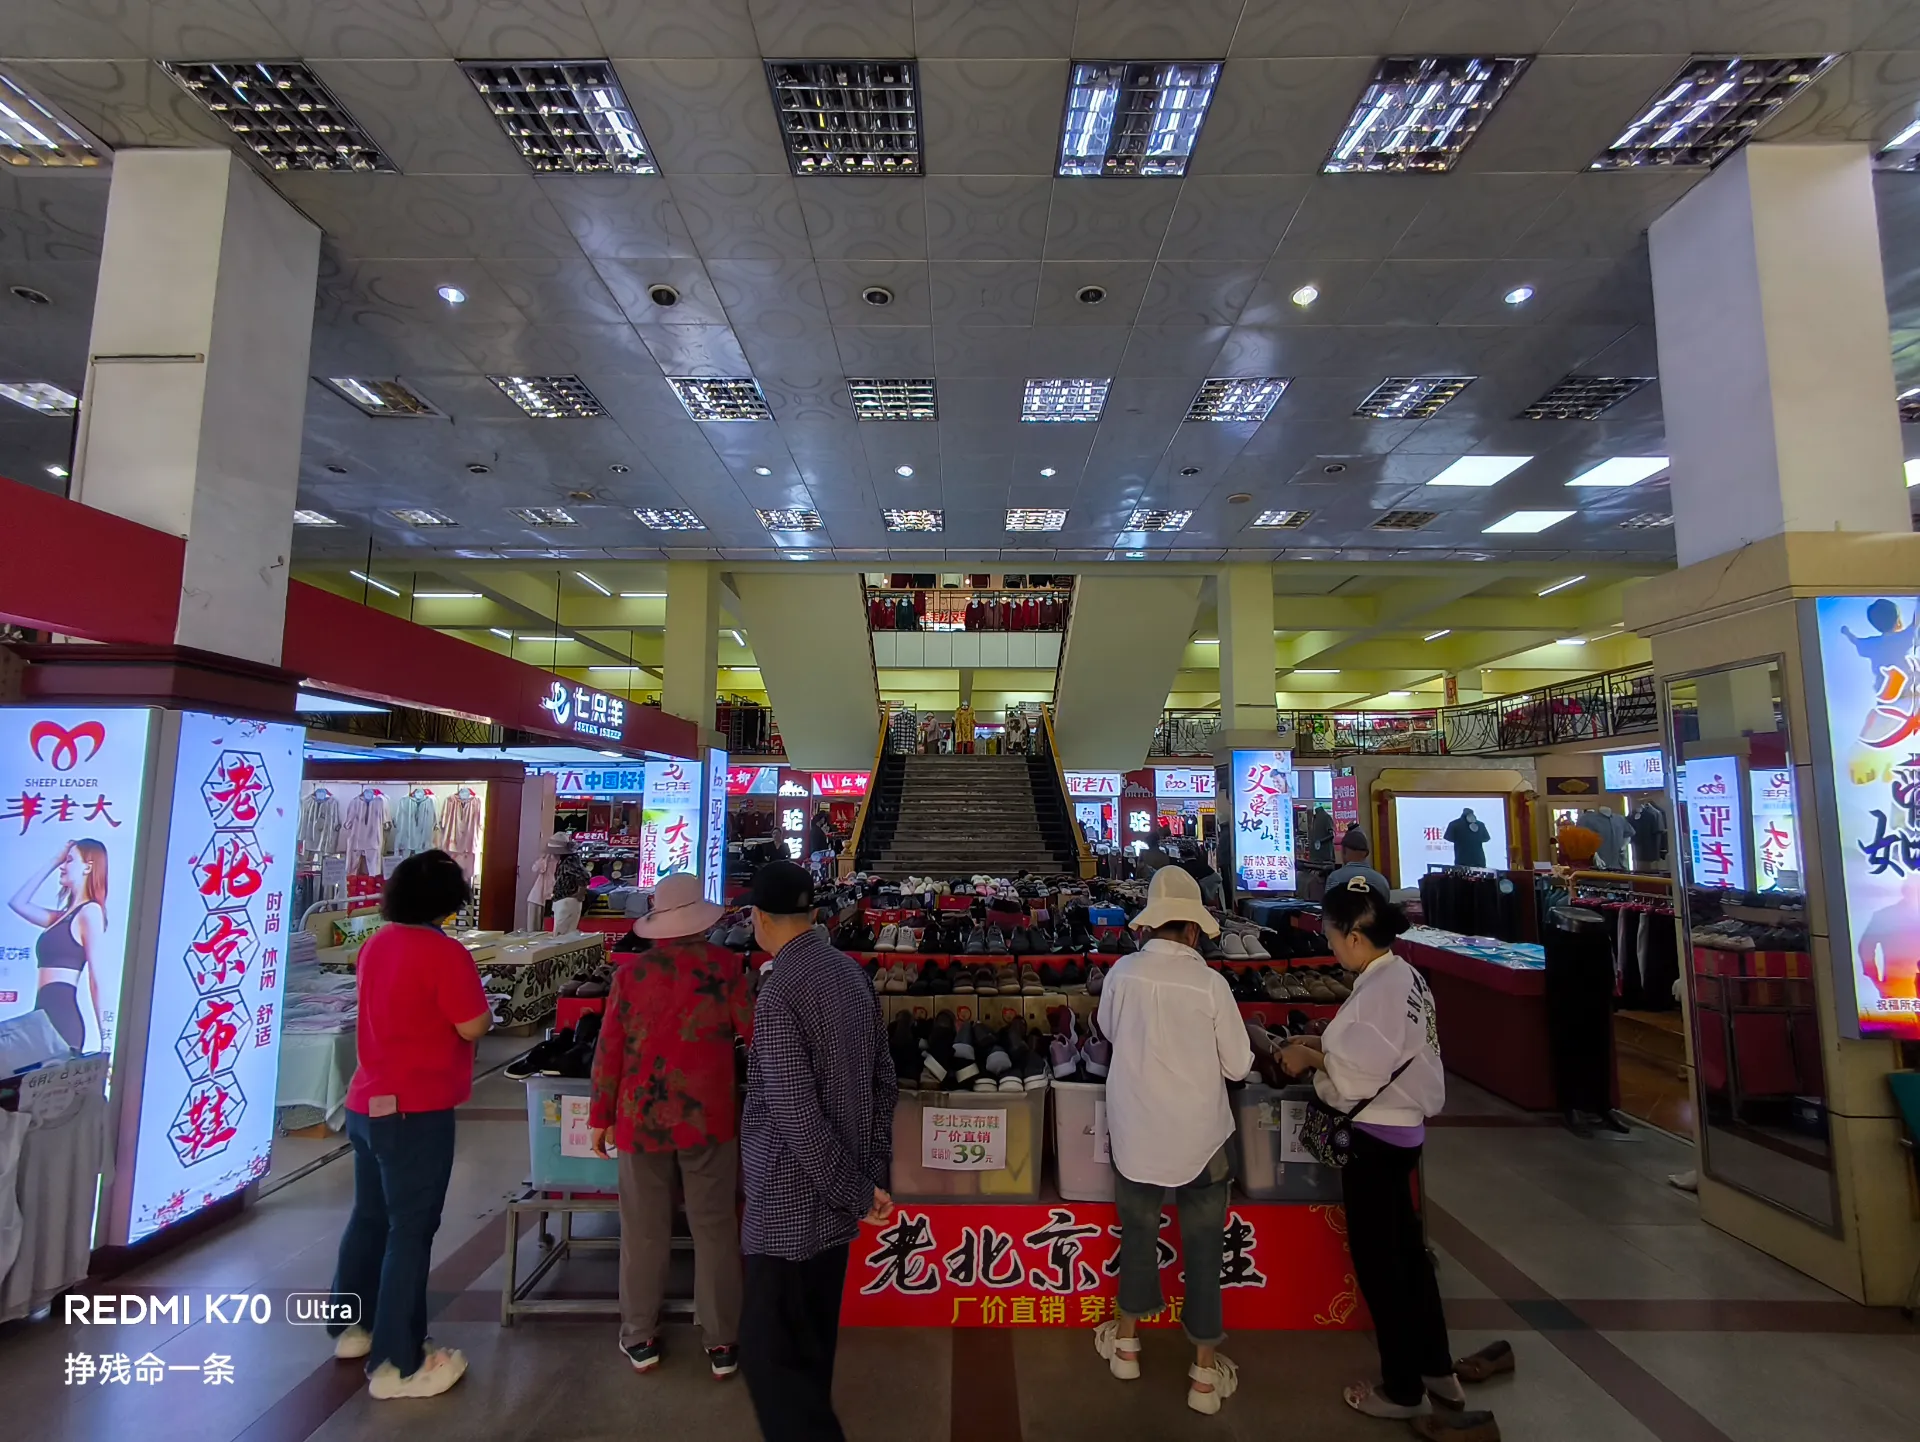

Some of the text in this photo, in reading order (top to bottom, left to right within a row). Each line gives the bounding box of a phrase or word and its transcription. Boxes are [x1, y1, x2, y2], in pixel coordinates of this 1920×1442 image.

[573, 687, 624, 727] 七只羊
[25, 779, 98, 787] SHEEP LEADER
[653, 781, 691, 791] 七只羊
[0, 791, 121, 836] 羊老大
[1243, 855, 1289, 867] 新款夏装
[1244, 868, 1289, 881] 感恩老爸
[178, 757, 264, 1160] 老北京布鞋
[255, 891, 283, 1048] 时尚 休闲 舒适
[932, 1114, 1000, 1129] 老北京布鞋
[933, 1130, 991, 1144] 厂价直销
[951, 1296, 1066, 1324] 厂价直销
